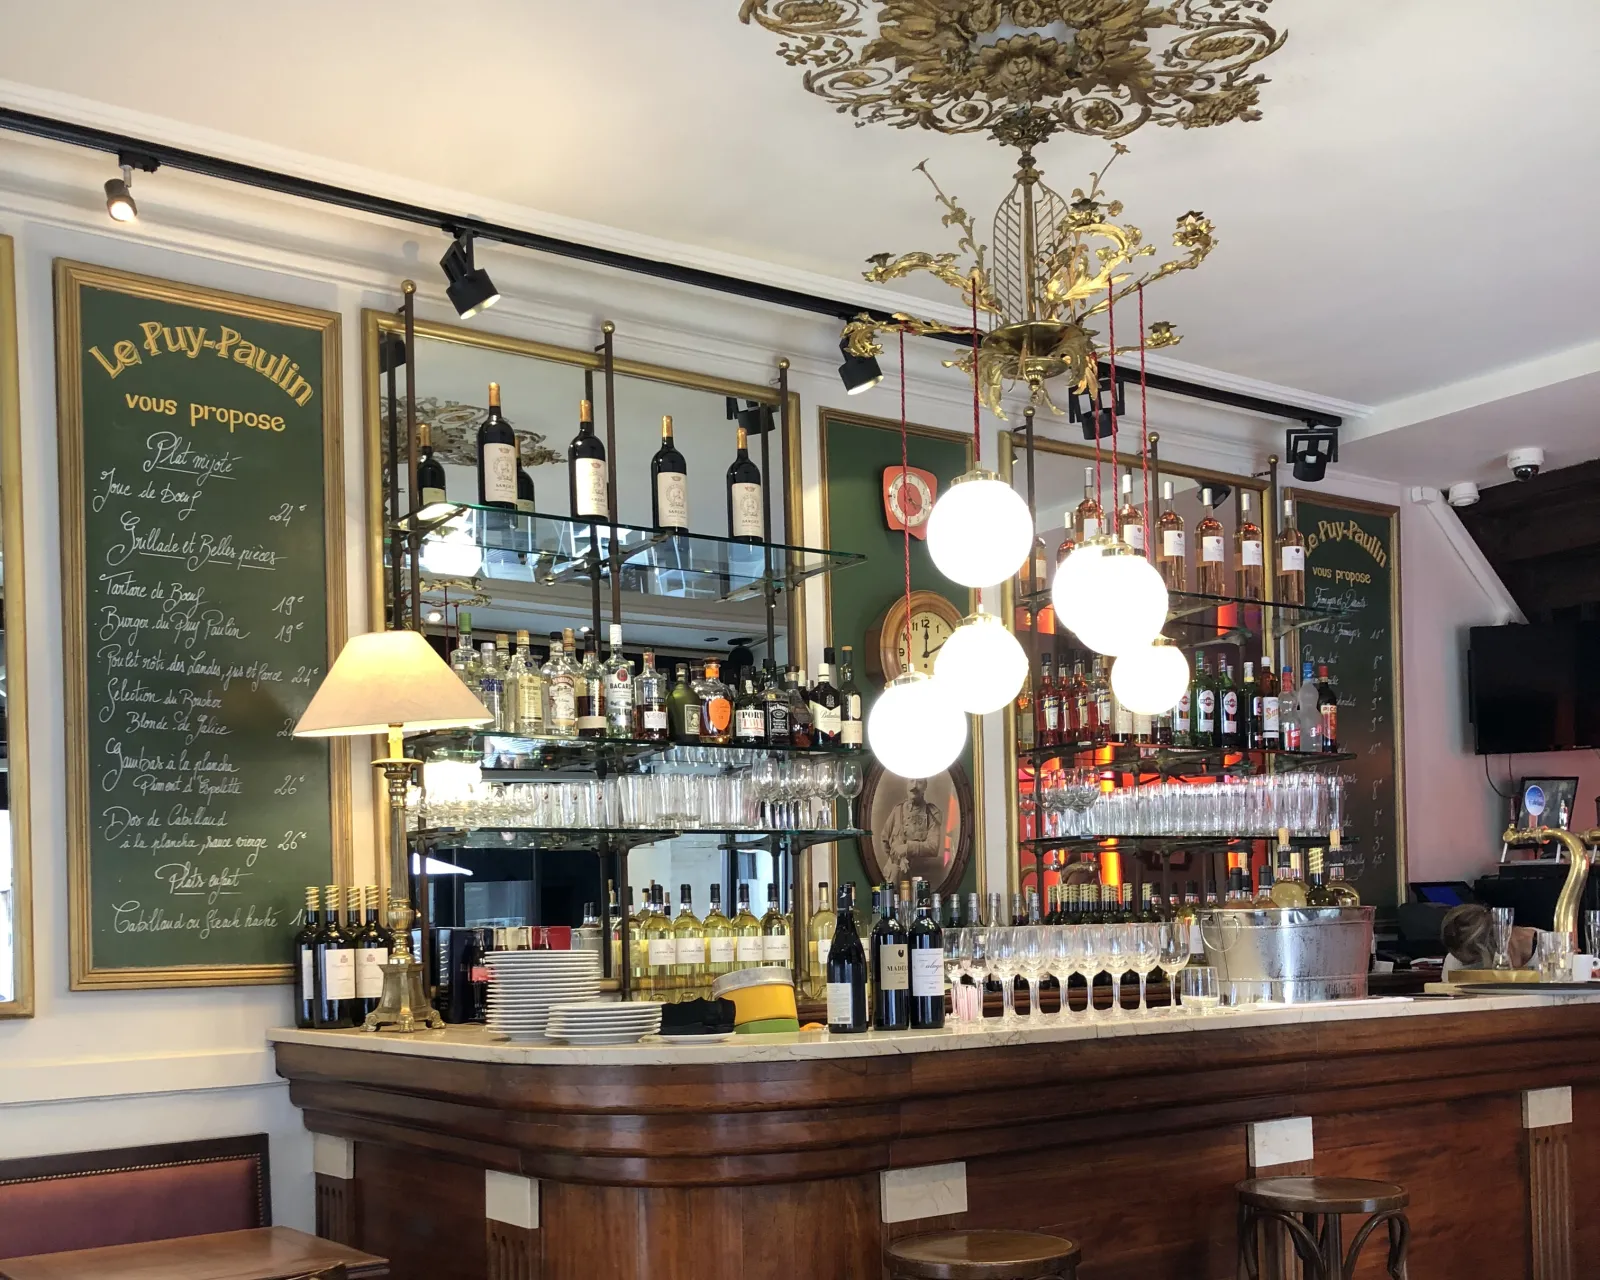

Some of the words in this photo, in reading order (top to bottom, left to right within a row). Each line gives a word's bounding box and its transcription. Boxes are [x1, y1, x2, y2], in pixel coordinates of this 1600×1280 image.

[88, 339, 143, 380] Le
[139, 320, 314, 408] Puy-Paulin
[125, 392, 178, 415] vous
[190, 402, 286, 433] propose
[142, 431, 194, 473] Plat
[193, 451, 243, 487] mijoté
[92, 467, 132, 513] Joue
[137, 480, 156, 499] de
[181, 531, 196, 554] et
[187, 534, 236, 572] Belles
[1317, 519, 1387, 568] Puy-Paulin
[99, 570, 148, 598] Tartare
[150, 581, 164, 600] de
[1311, 566, 1333, 579] vous
[1335, 569, 1372, 587] propose
[99, 605, 149, 647] Burger
[152, 613, 170, 631] du
[169, 611, 200, 649] Puy
[201, 609, 251, 641] Paulin
[911, 622, 918, 631] 11
[921, 619, 930, 629] 12
[96, 643, 139, 676] Poulet
[169, 655, 186, 674] des
[898, 647, 906, 657] 9
[163, 689, 178, 706] du
[125, 711, 169, 734] Blonde
[165, 753, 176, 771] à
[179, 748, 191, 772] la
[192, 751, 241, 781] plancha
[102, 805, 145, 842] Dos
[146, 809, 162, 828] de
[166, 803, 228, 828] Cabillaud
[111, 899, 185, 935] Cabillaud
[186, 919, 200, 932] ou
